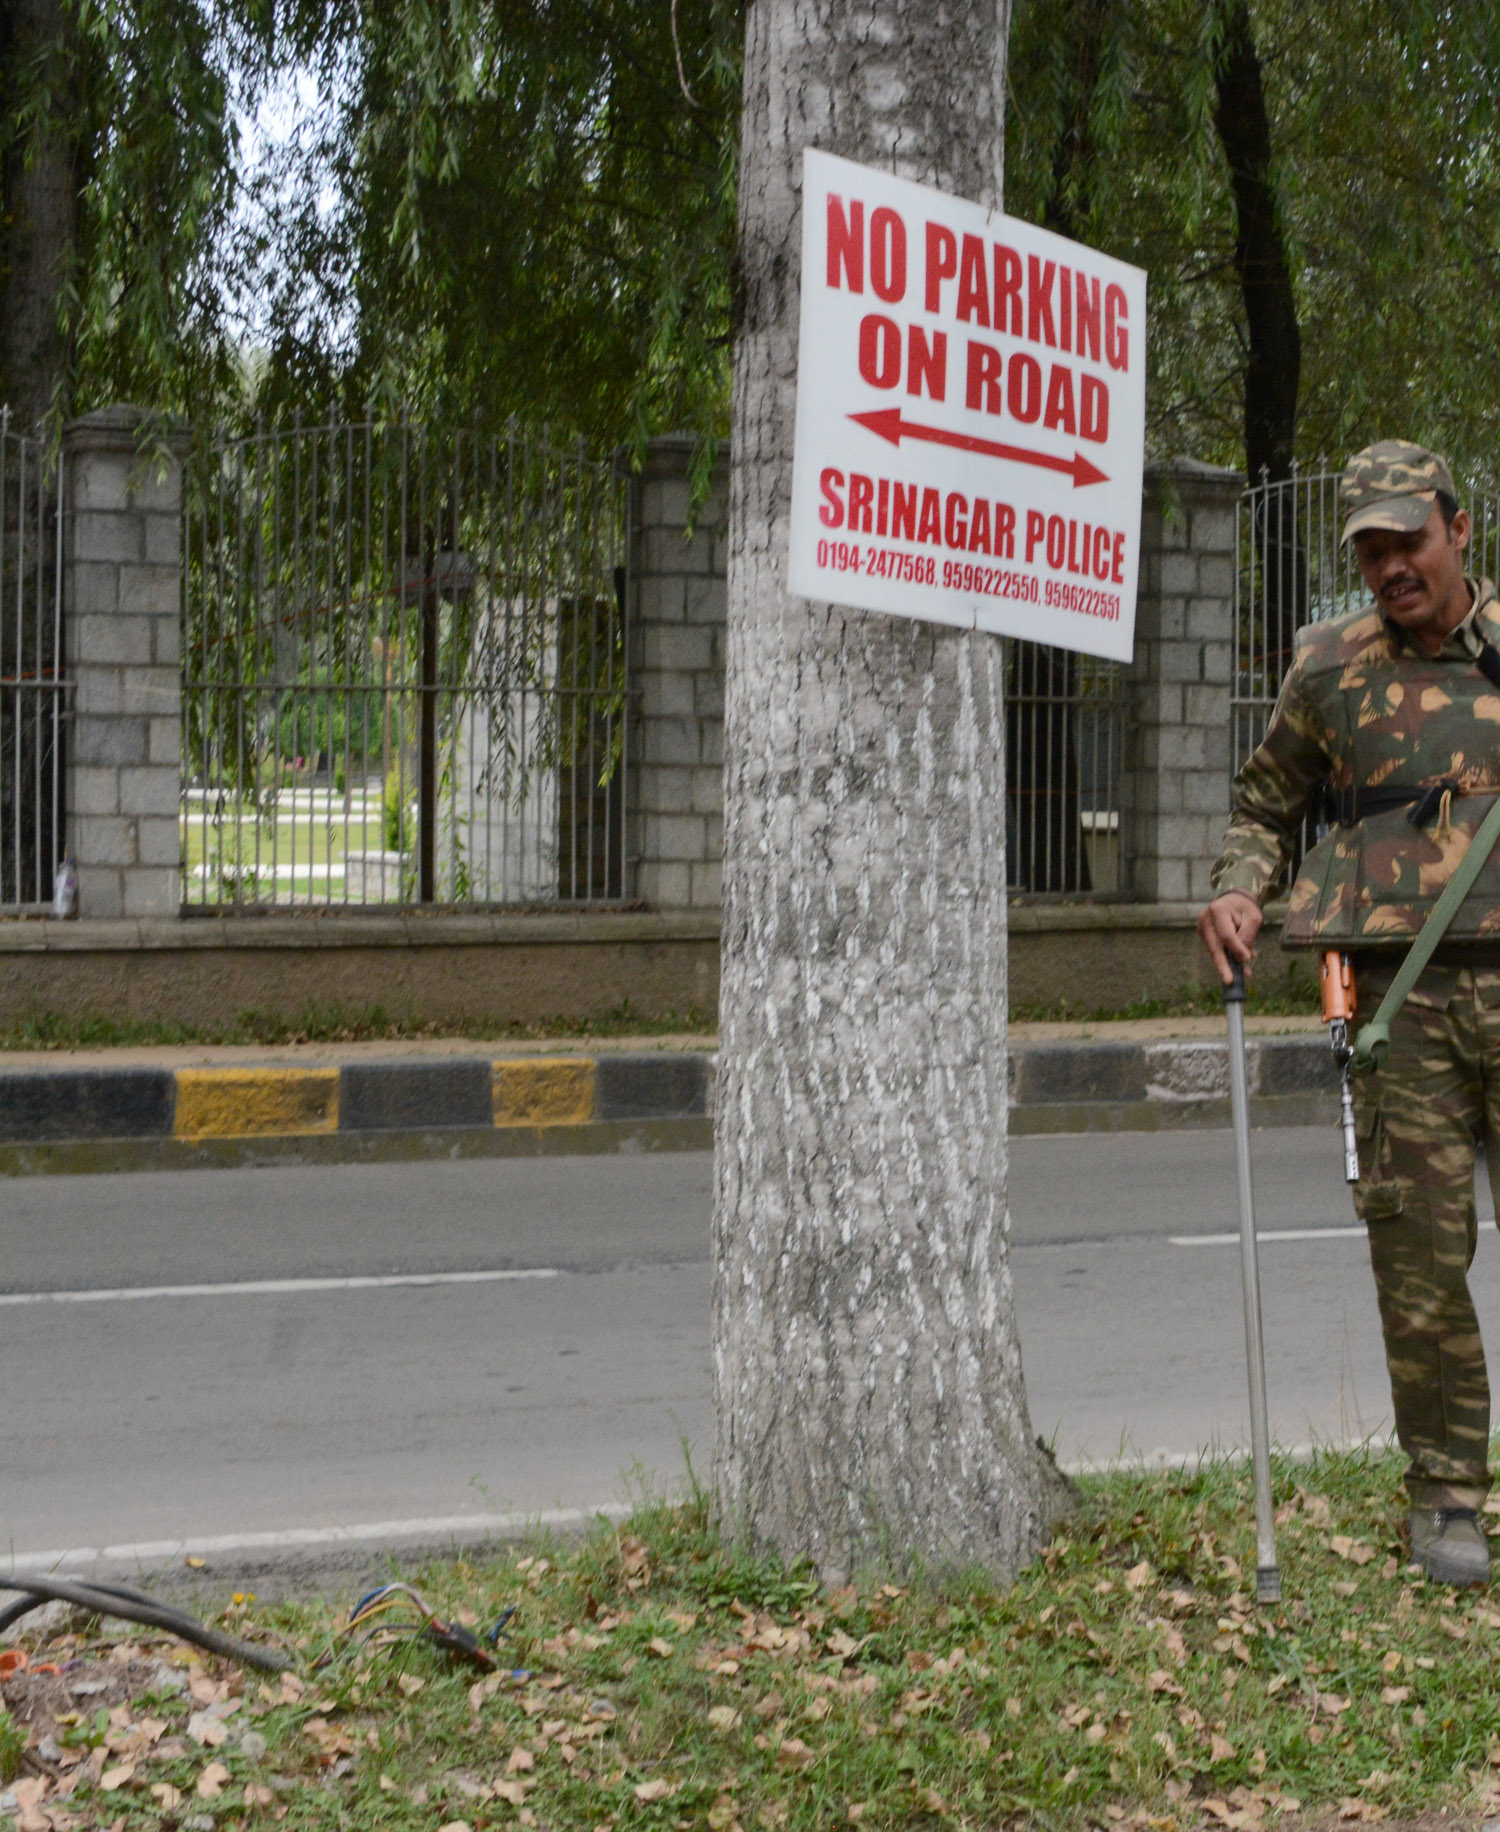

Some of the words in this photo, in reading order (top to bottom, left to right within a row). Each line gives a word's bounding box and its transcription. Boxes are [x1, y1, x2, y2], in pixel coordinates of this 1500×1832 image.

[826, 192, 908, 305] NO
[924, 220, 1130, 373] PARKING
[858, 313, 948, 403] ON
[965, 339, 1110, 445] ROAD
[816, 538, 938, 590] 0194-2477568,
[942, 560, 1042, 608] 9596222550,
[1044, 579, 1121, 622] 9596222551
[818, 466, 1017, 561] SRINAGAR
[1024, 508, 1126, 585] POLICE
